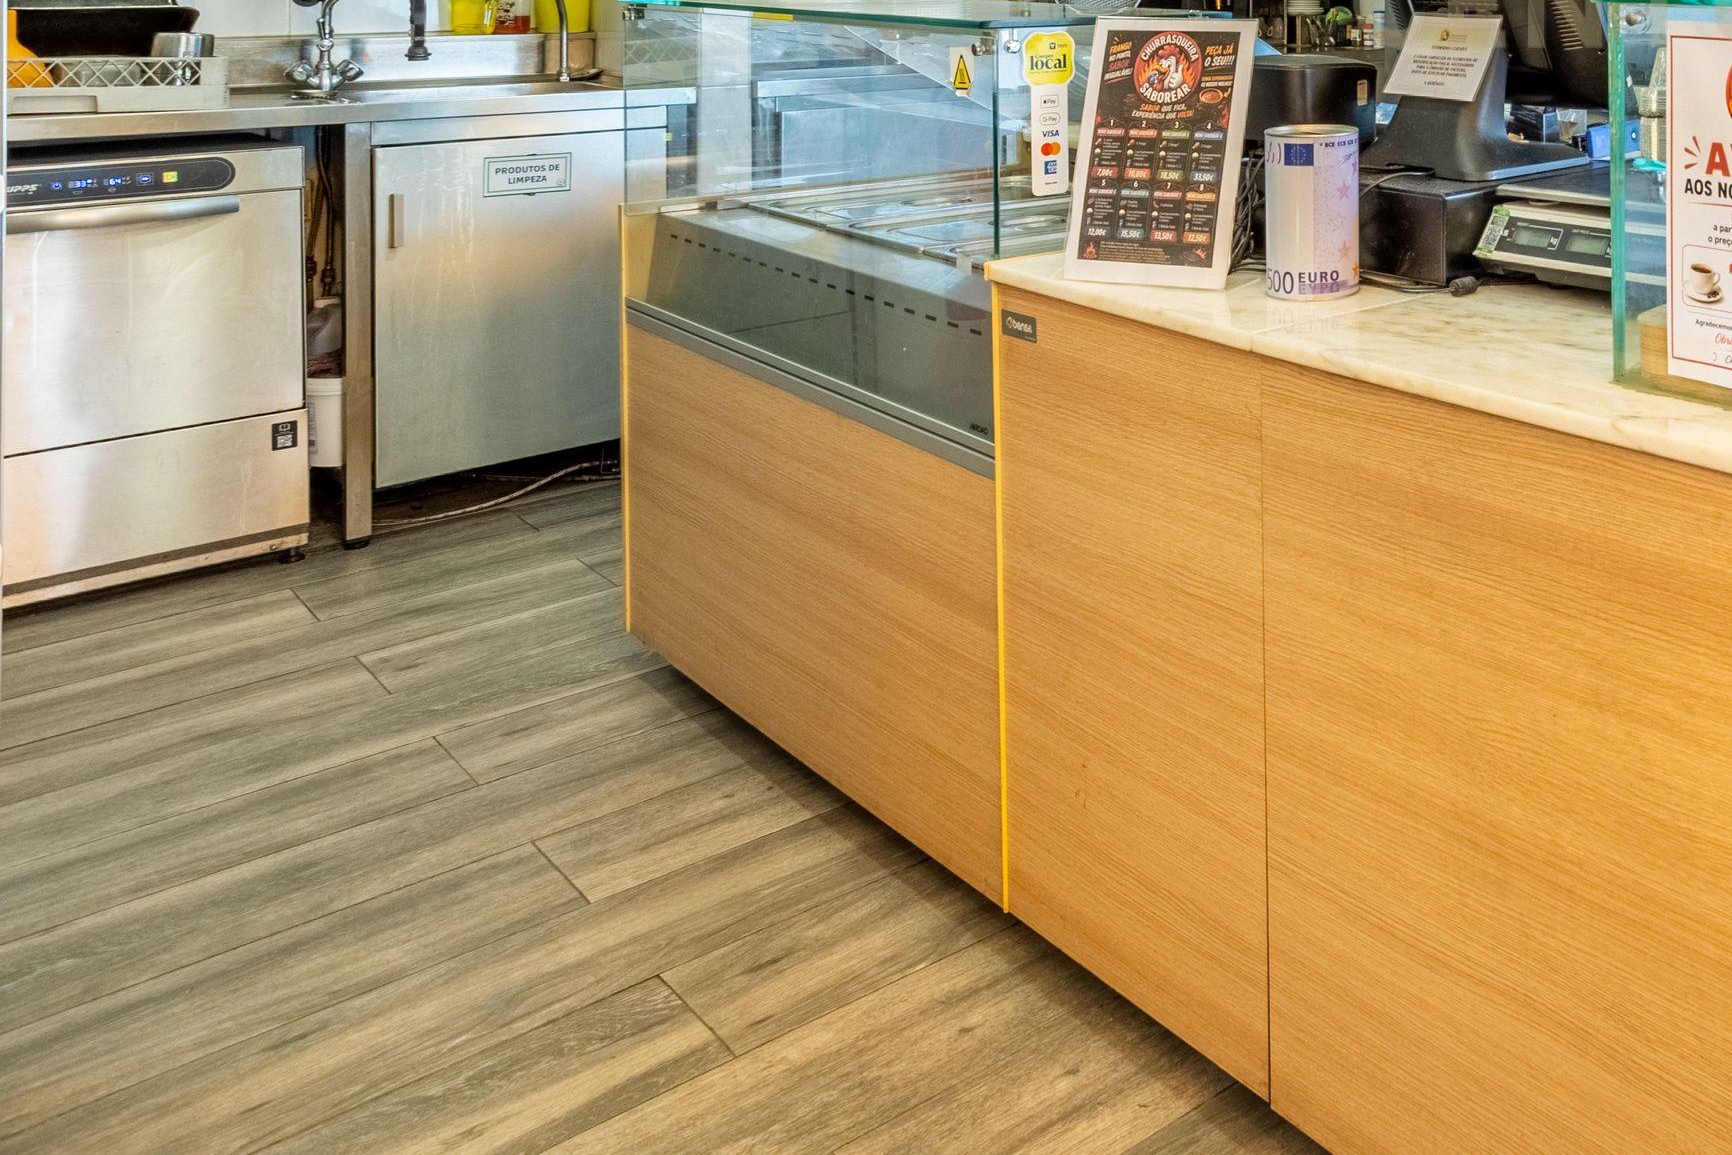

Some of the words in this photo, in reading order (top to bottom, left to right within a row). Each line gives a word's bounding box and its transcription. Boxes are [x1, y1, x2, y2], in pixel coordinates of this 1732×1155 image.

[1109, 41, 1133, 54] FRANGO
[1141, 34, 1200, 62] CHURRASQUEIRA
[1205, 45, 1222, 57] PEÇA
[1222, 42, 1235, 54] JÁ
[1030, 54, 1067, 70] local
[1108, 58, 1131, 72] SABOR
[1204, 57, 1211, 68] O
[1140, 82, 1192, 104] SABOREAR
[1139, 103, 1161, 112] SABOR
[1161, 103, 1173, 112] QUE
[1131, 109, 1166, 120] EXPERIÊNCIA
[1165, 111, 1177, 120] QUE
[1110, 119, 1114, 127] 1
[1141, 120, 1146, 128] 2
[1174, 121, 1179, 129] 3
[1206, 122, 1212, 130] 4
[1041, 129, 1060, 137] VISA
[495, 164, 546, 175] PRODUTOS
[548, 163, 561, 171] DE
[508, 175, 547, 185] LIMPEZA
[1193, 172, 1215, 182] 33,50€
[7, 183, 39, 194] UPPS
[1101, 179, 1106, 187] 5
[1133, 180, 1138, 188] 6
[1684, 178, 1713, 197] AOS
[1267, 269, 1294, 295] 500
[1298, 270, 1340, 284] EURO
